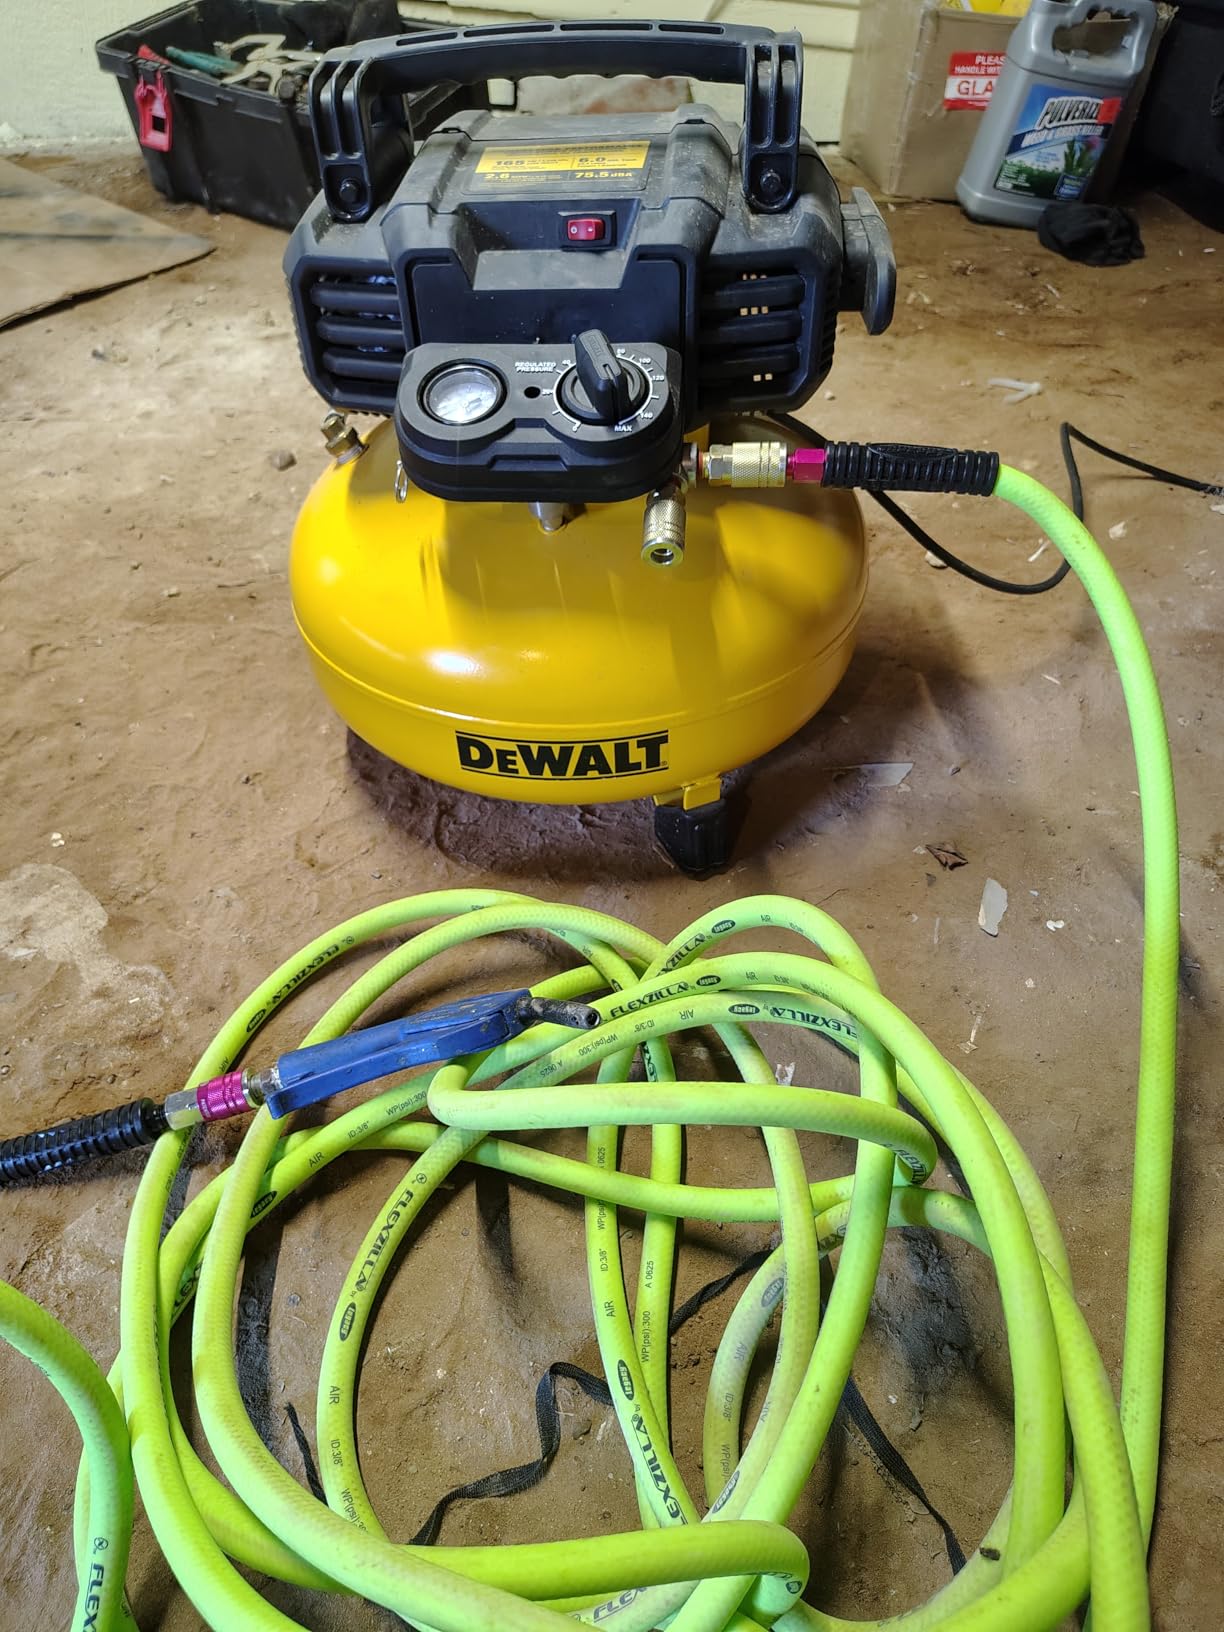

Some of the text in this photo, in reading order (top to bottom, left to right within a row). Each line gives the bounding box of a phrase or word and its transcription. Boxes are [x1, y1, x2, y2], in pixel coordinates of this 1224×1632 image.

[575, 171, 609, 179] 75.5
[614, 425, 632, 433] MAX
[456, 735, 669, 777] DEWALT
[610, 981, 689, 1018] FLEXZILLA
[679, 1008, 695, 1020] AIR
[308, 1151, 325, 1168] AIR
[385, 1090, 427, 1116] WP(psi):300
[355, 1188, 414, 1292] FLEXZILLA
[604, 1300, 616, 1318] AIR
[641, 1310, 652, 1363] WP(psi):300
[329, 1385, 341, 1405] AIR
